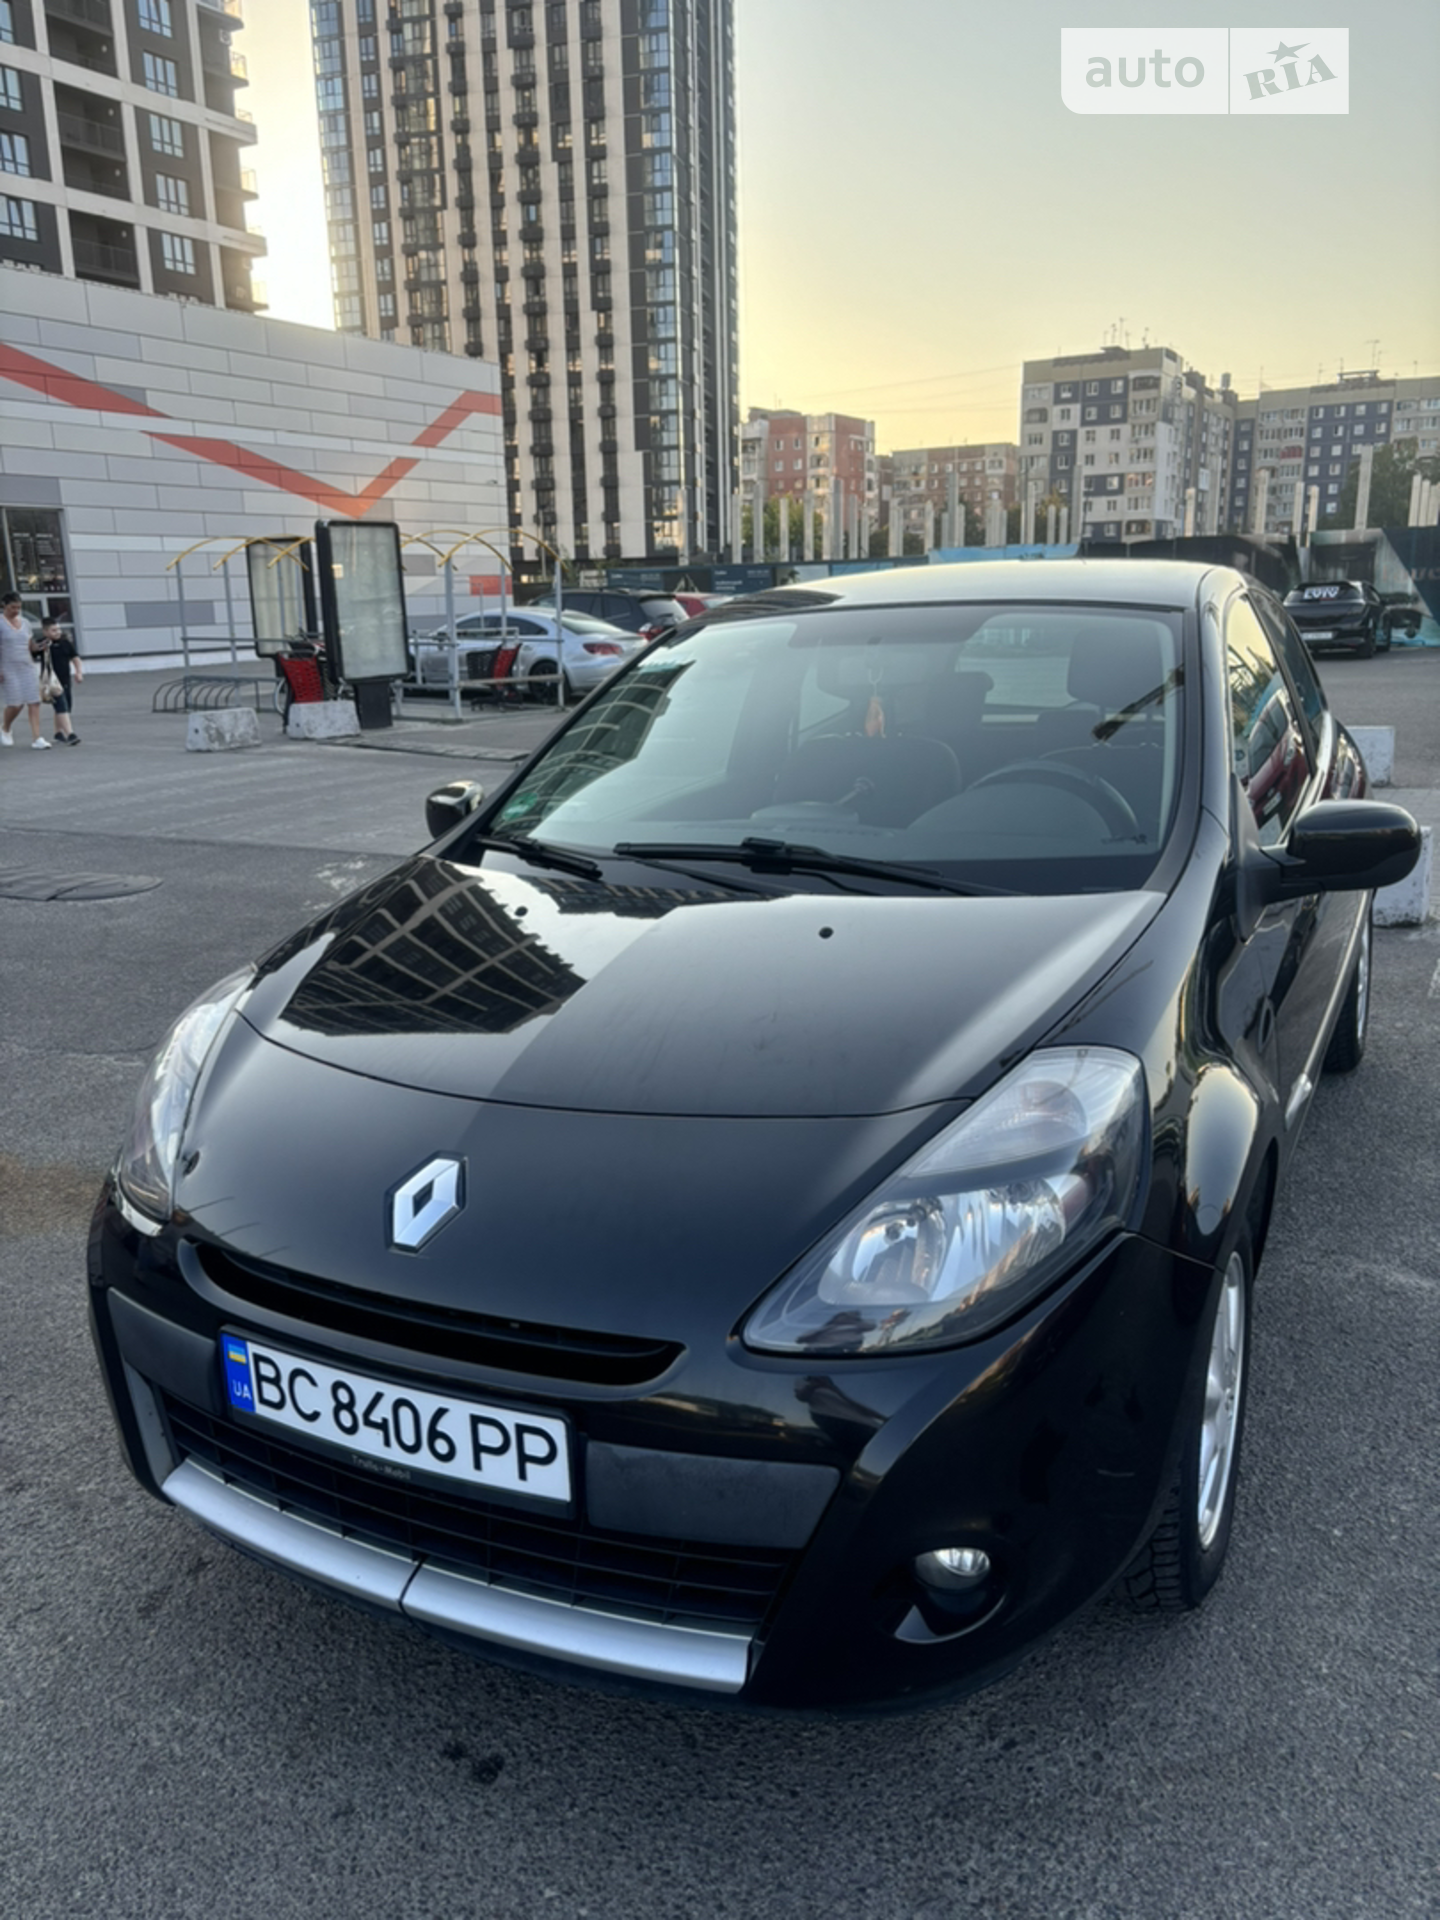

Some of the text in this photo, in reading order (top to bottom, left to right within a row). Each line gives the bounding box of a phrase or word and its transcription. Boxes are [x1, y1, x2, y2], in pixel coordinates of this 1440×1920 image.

[232, 1379, 252, 1401] UA
[251, 1351, 559, 1482] BC 8406 PP
